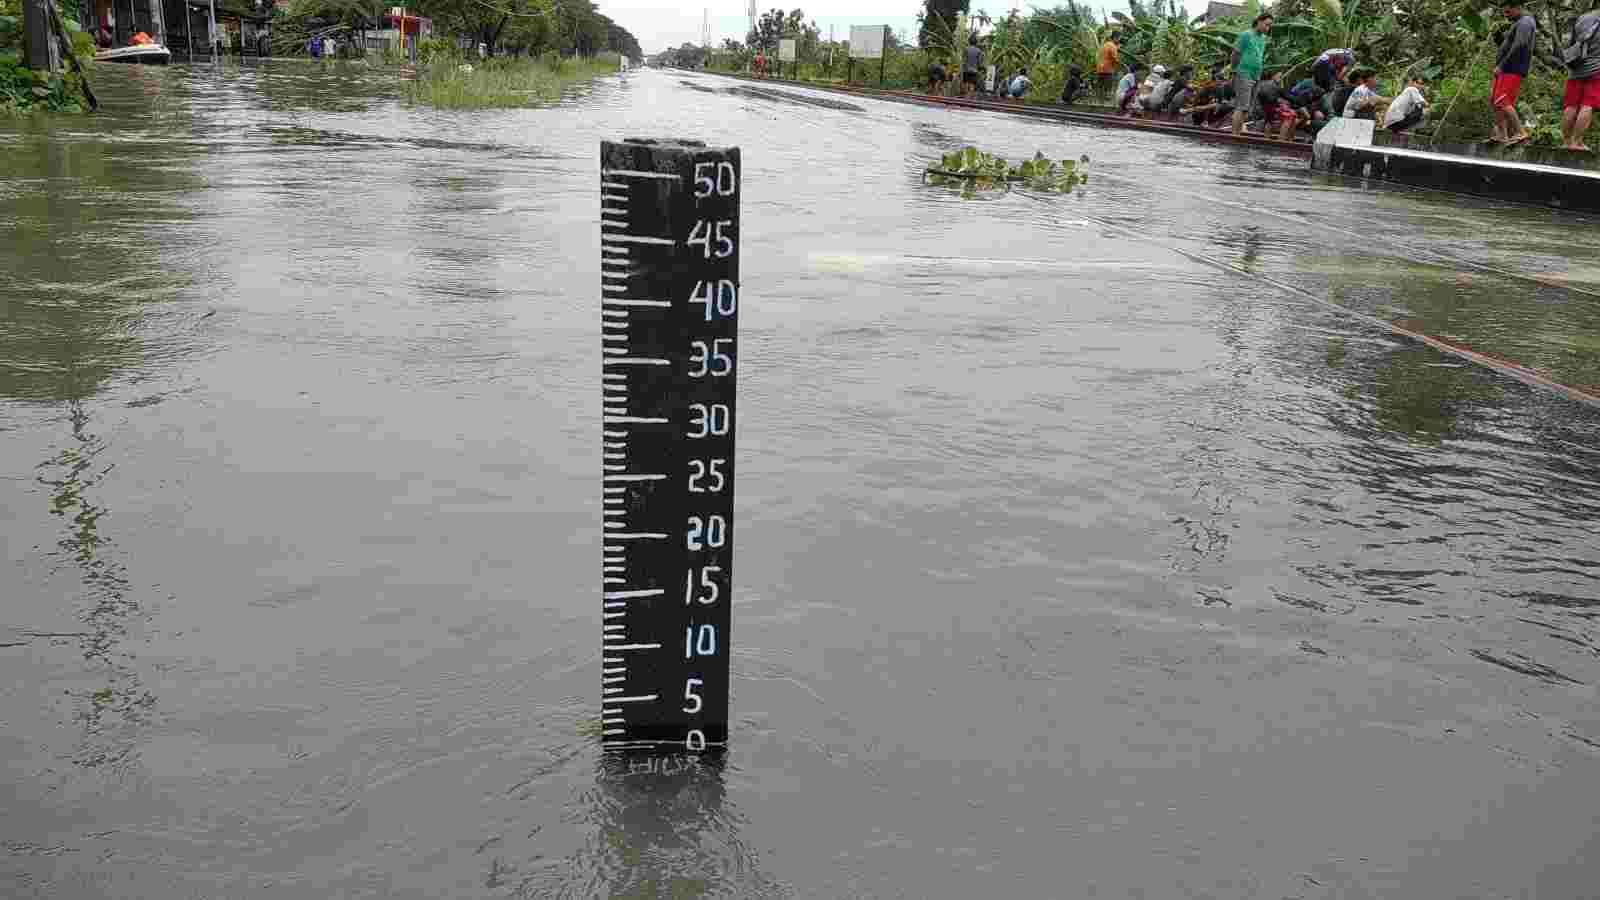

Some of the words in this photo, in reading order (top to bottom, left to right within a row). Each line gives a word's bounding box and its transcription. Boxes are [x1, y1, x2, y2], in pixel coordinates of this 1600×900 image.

[694, 162, 735, 198] 50
[687, 220, 733, 258] 45
[689, 280, 736, 321] 40
[688, 339, 733, 378] 35
[687, 404, 729, 438] 30
[688, 459, 725, 492] 25
[688, 516, 725, 550] 20
[686, 566, 721, 604] 15
[686, 625, 715, 658] 10
[683, 679, 703, 713] 5
[686, 730, 705, 750] 0
